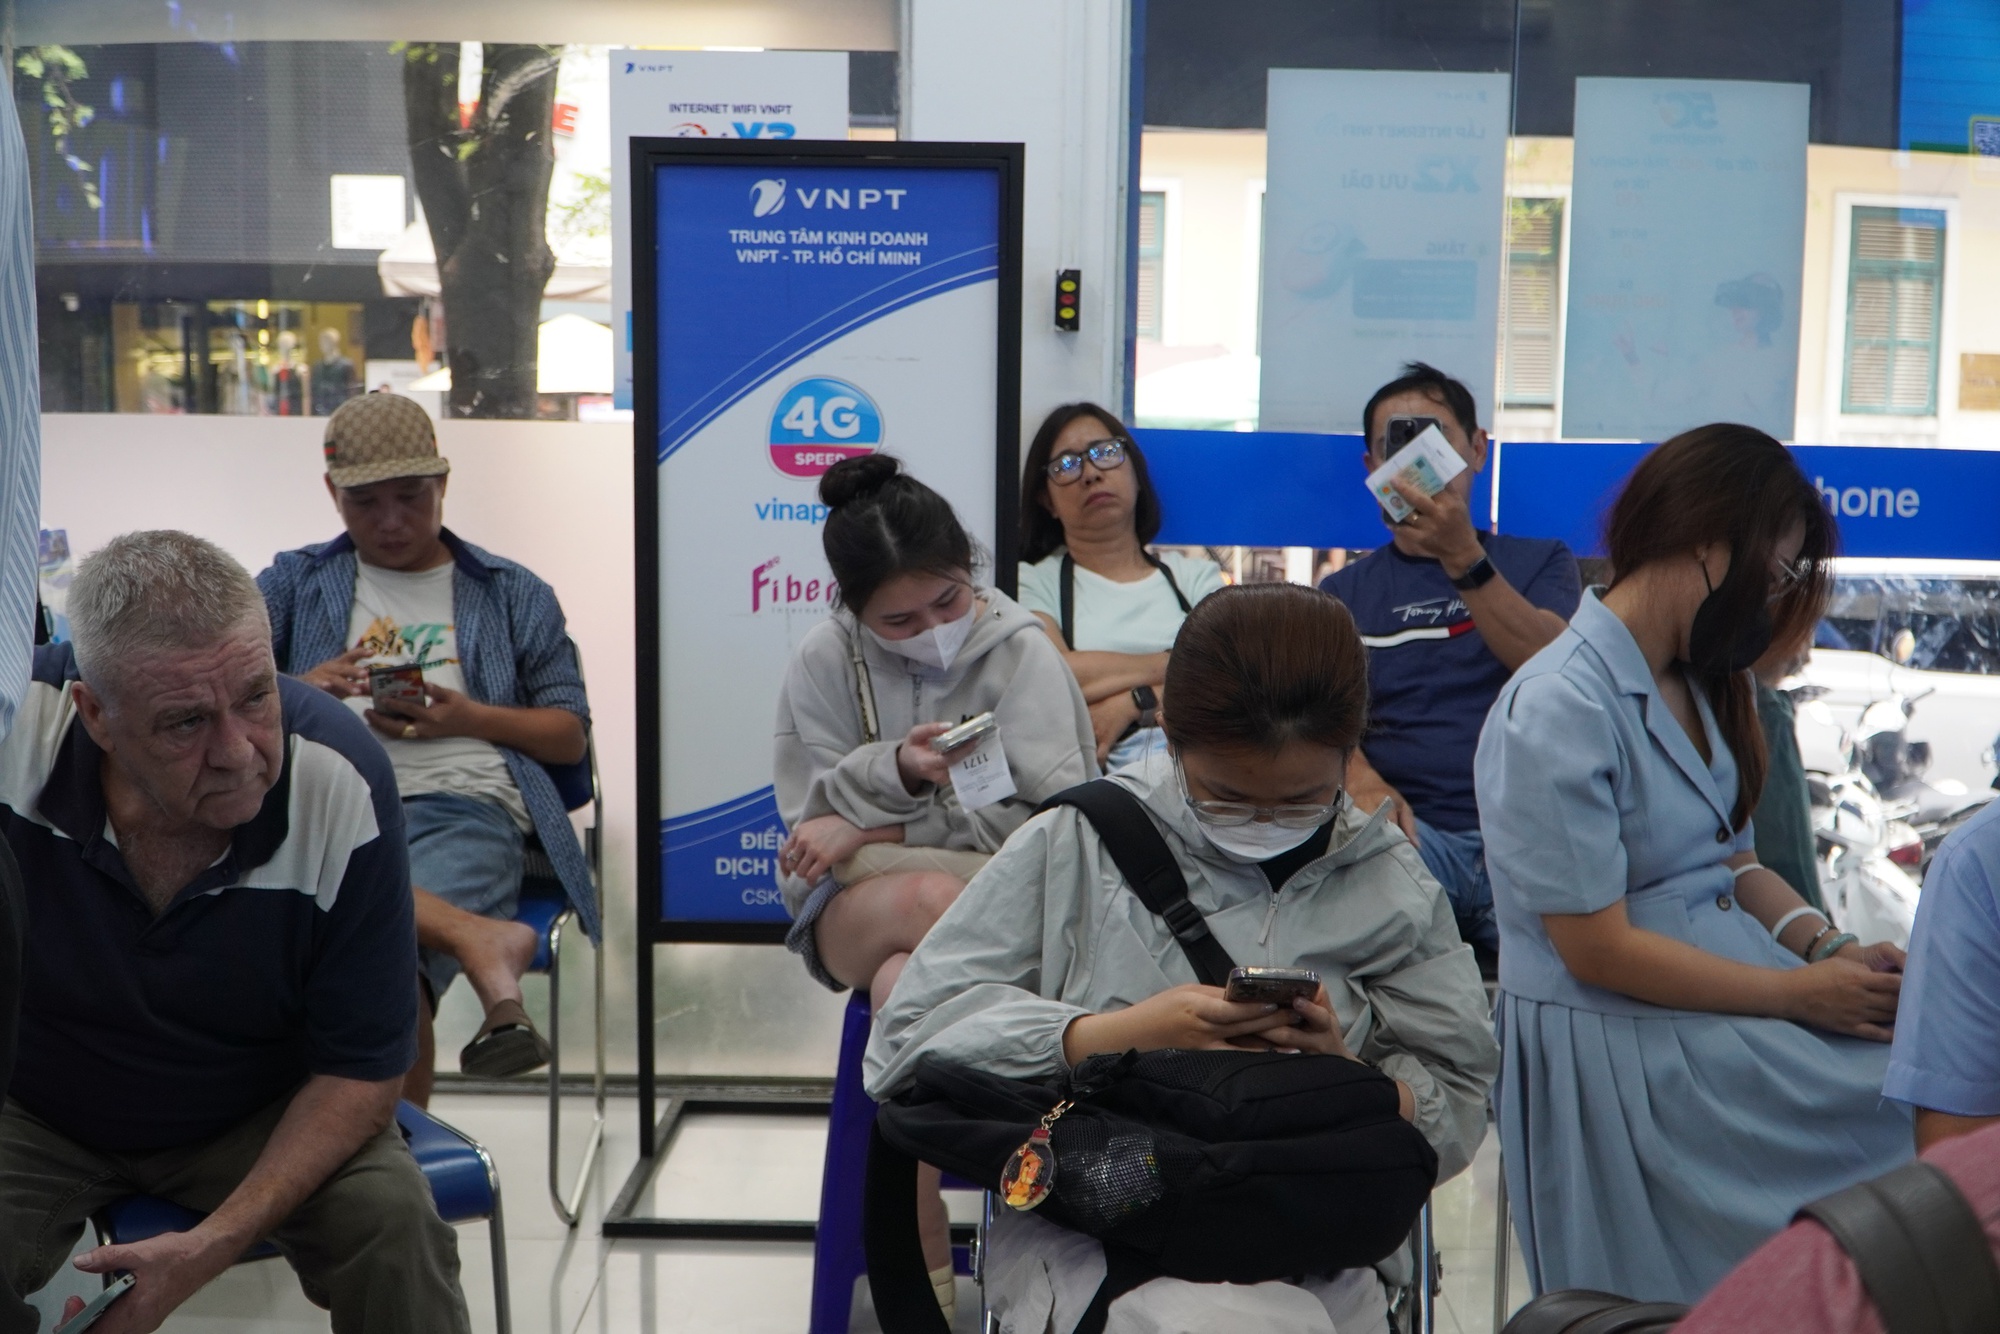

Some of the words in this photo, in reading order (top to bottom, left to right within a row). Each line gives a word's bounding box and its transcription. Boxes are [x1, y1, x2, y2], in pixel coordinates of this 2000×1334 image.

[669, 103, 728, 114] INTERNET
[732, 103, 757, 114] WIFI
[760, 104, 793, 115] VNPT
[795, 187, 908, 211] VNPT
[728, 229, 786, 244] TRUNG
[789, 227, 823, 245] TÂM
[827, 230, 866, 246] KINH
[870, 231, 928, 247] DOANH
[736, 249, 779, 264] VNPT
[792, 250, 815, 264] TP.
[819, 246, 843, 265] HỒ
[847, 248, 875, 266] CHÍ
[878, 251, 921, 266] MINH
[781, 395, 861, 439] 4G
[1815, 476, 1920, 518] hone
[755, 497, 829, 525] vinap
[715, 857, 769, 880] DỊCH
[741, 888, 784, 906] CSK
